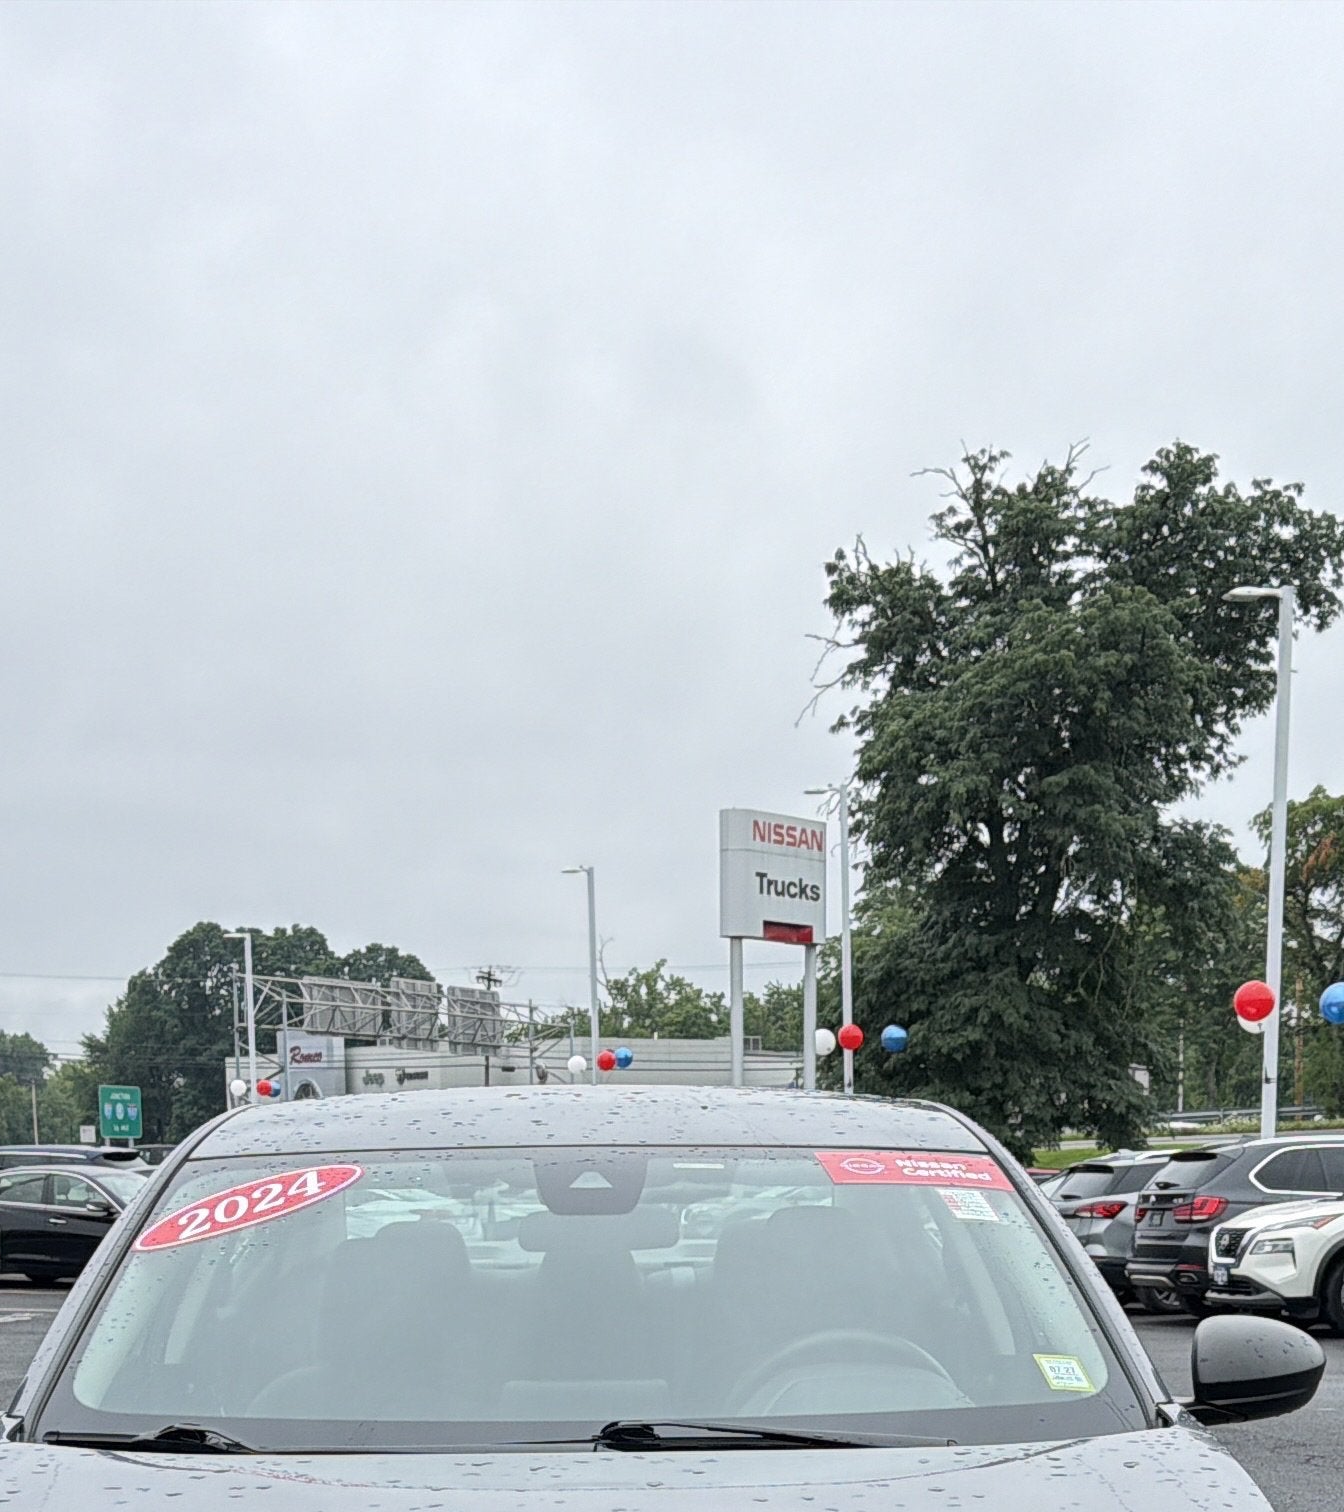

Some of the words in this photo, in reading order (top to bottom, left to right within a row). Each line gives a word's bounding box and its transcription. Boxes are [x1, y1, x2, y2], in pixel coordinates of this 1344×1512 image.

[752, 819, 824, 852] NISSAN
[755, 871, 821, 902] Trucks
[895, 1159, 967, 1171] Nissan
[902, 1167, 993, 1181] Certified
[177, 1170, 326, 1240] 2024
